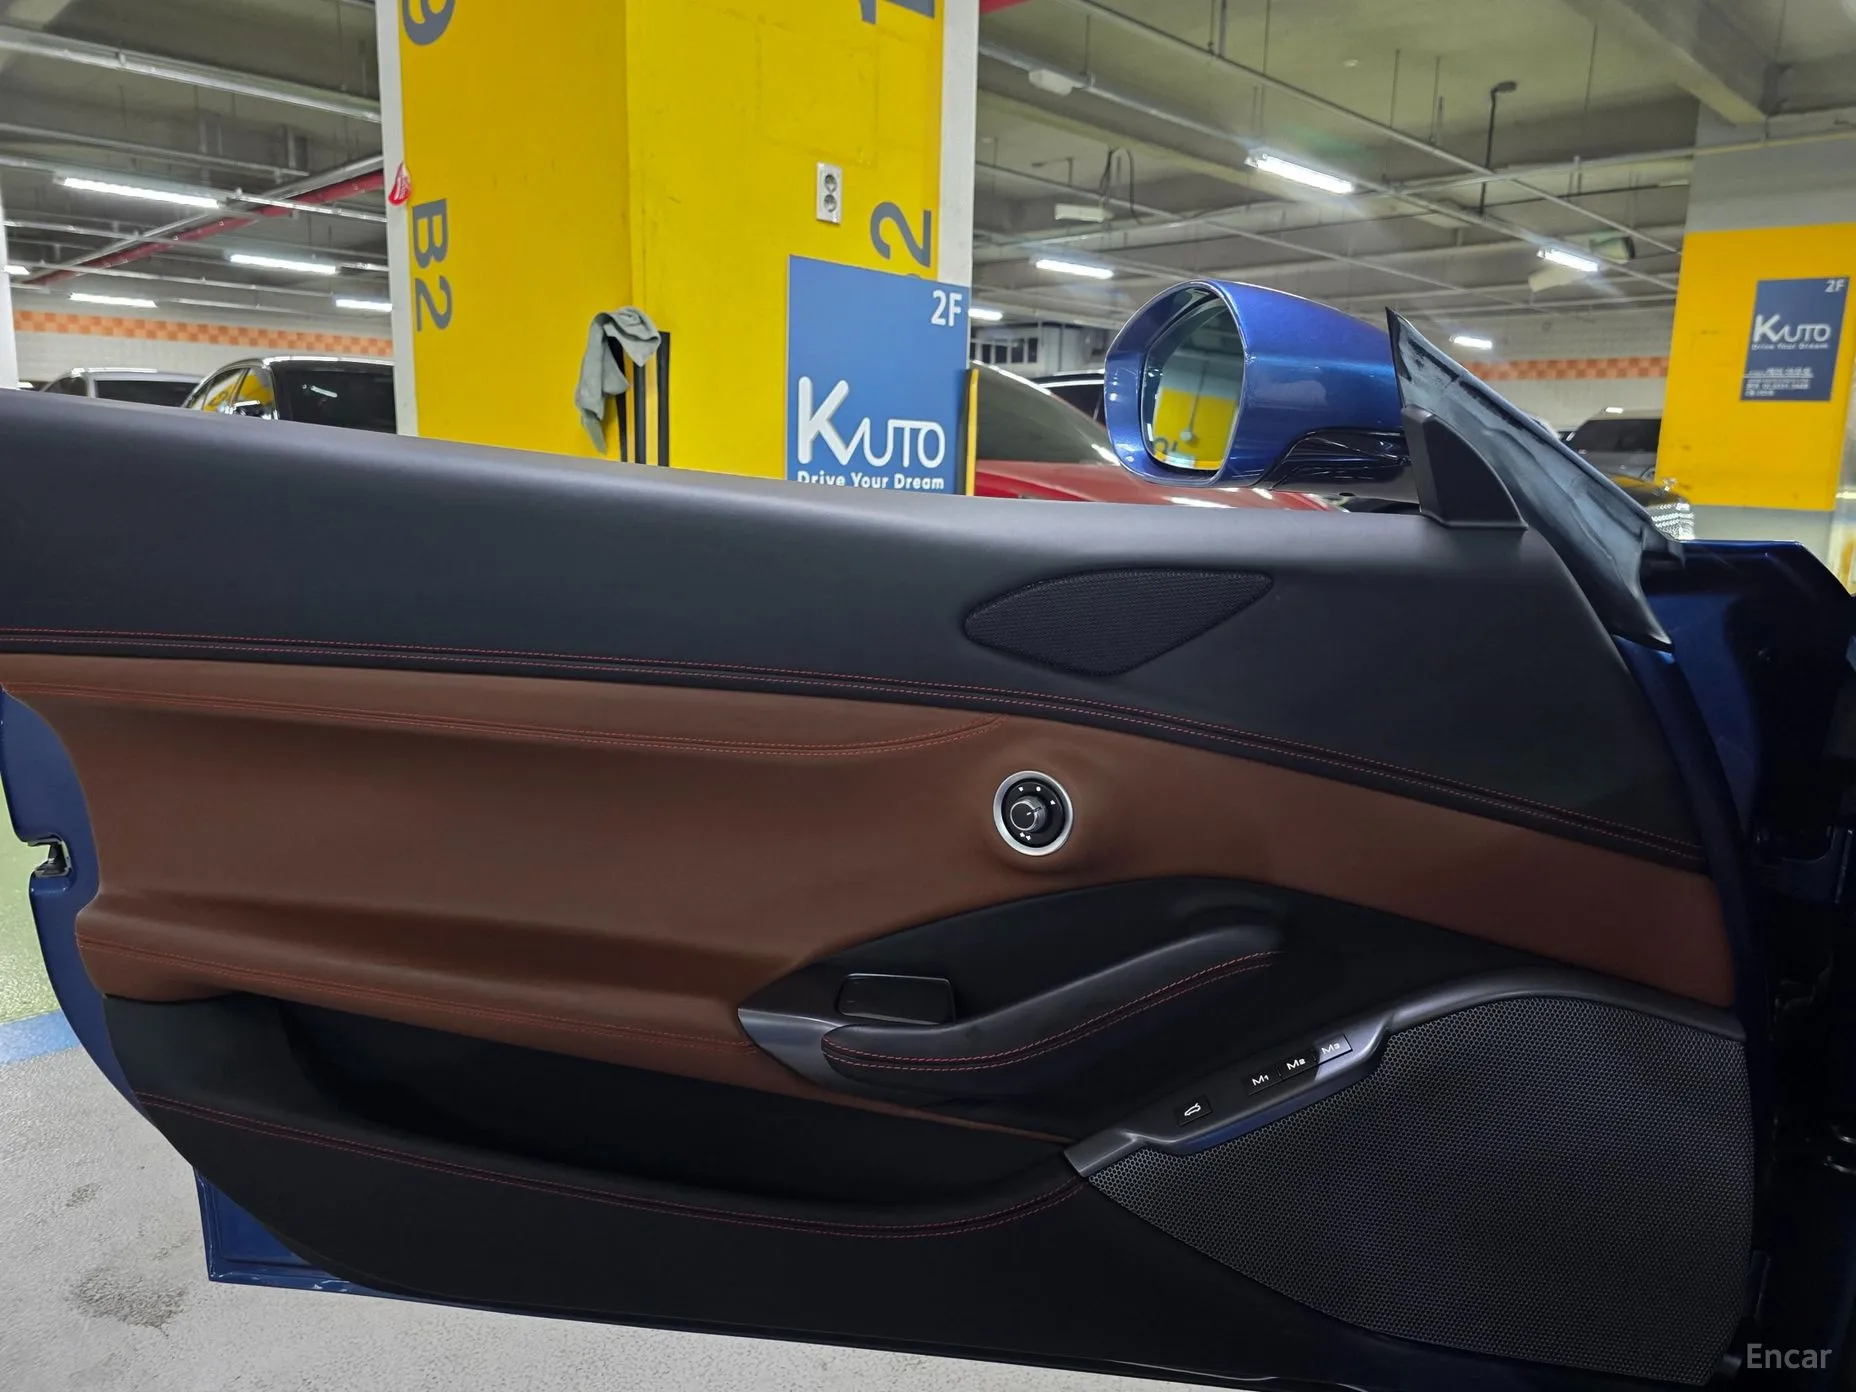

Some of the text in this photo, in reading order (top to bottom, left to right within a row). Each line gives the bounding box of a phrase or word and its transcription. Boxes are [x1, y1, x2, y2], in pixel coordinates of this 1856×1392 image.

[412, 198, 453, 332] B2
[1825, 279, 1844, 293] 2F
[931, 289, 962, 327] 2F
[797, 470, 945, 490] Drive Your Dream
[1251, 1042, 1341, 1086] M1 M2 M3
